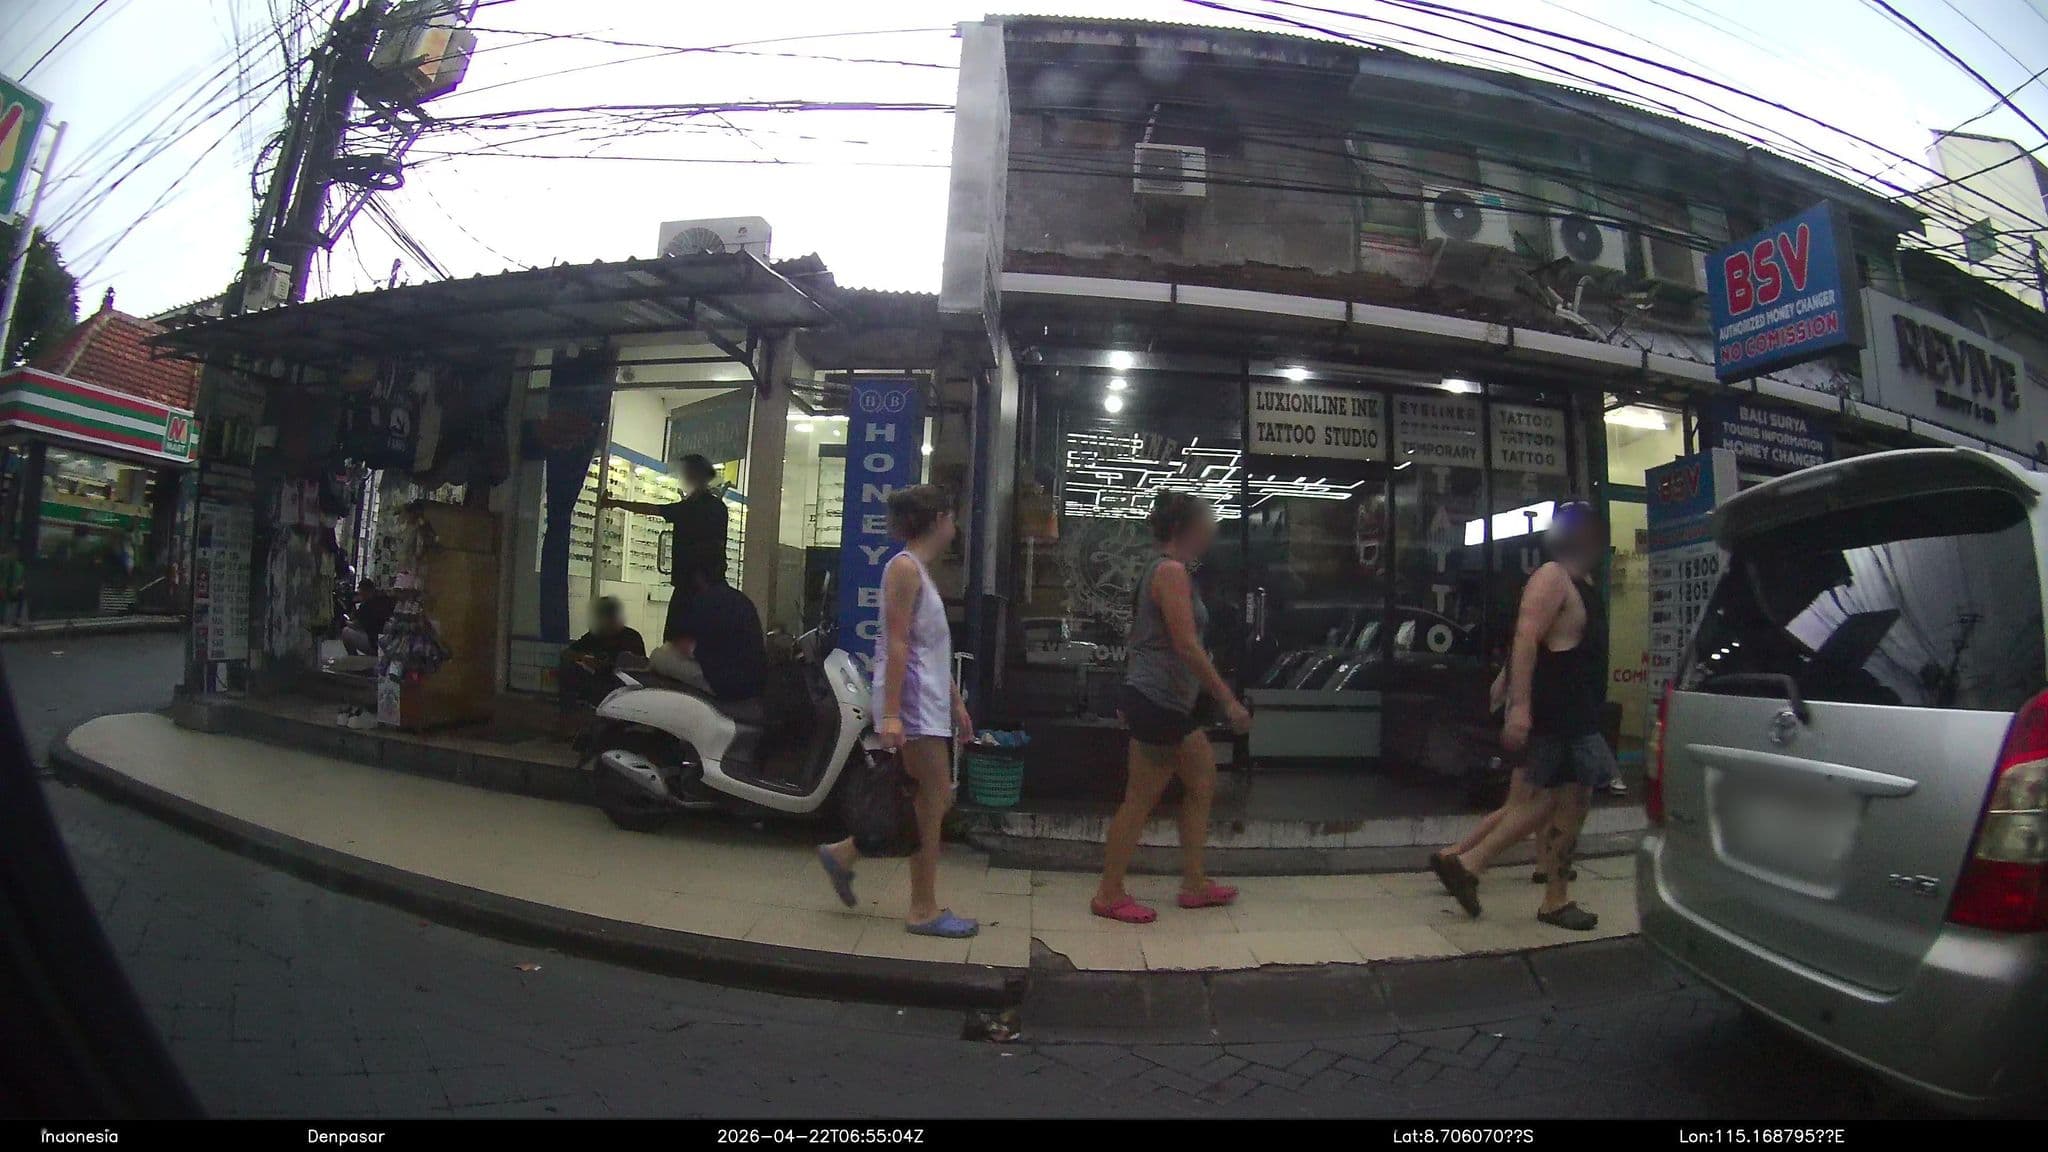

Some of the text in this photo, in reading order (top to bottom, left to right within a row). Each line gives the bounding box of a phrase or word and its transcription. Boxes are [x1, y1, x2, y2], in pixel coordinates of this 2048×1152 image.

[1723, 222, 1809, 316] BSV
[1719, 289, 1836, 340] AUTHORIZED MONEY CHANGER
[1720, 310, 1838, 365] NO COMISSION
[1892, 314, 2021, 412] REVIVE
[1256, 391, 1378, 418] LUXIONLINE INK
[1500, 410, 1553, 429] TATTOO
[1739, 406, 1808, 432] BALI SURYA
[1257, 421, 1316, 444] TATTOO
[1324, 425, 1379, 448] STUDIO
[1762, 429, 1824, 452] INFORMATION
[1402, 441, 1477, 461] TEMPORARY
[1502, 449, 1556, 467] TATTOO
[1722, 438, 1770, 461] MONEY
[860, 422, 896, 566] HONEY
